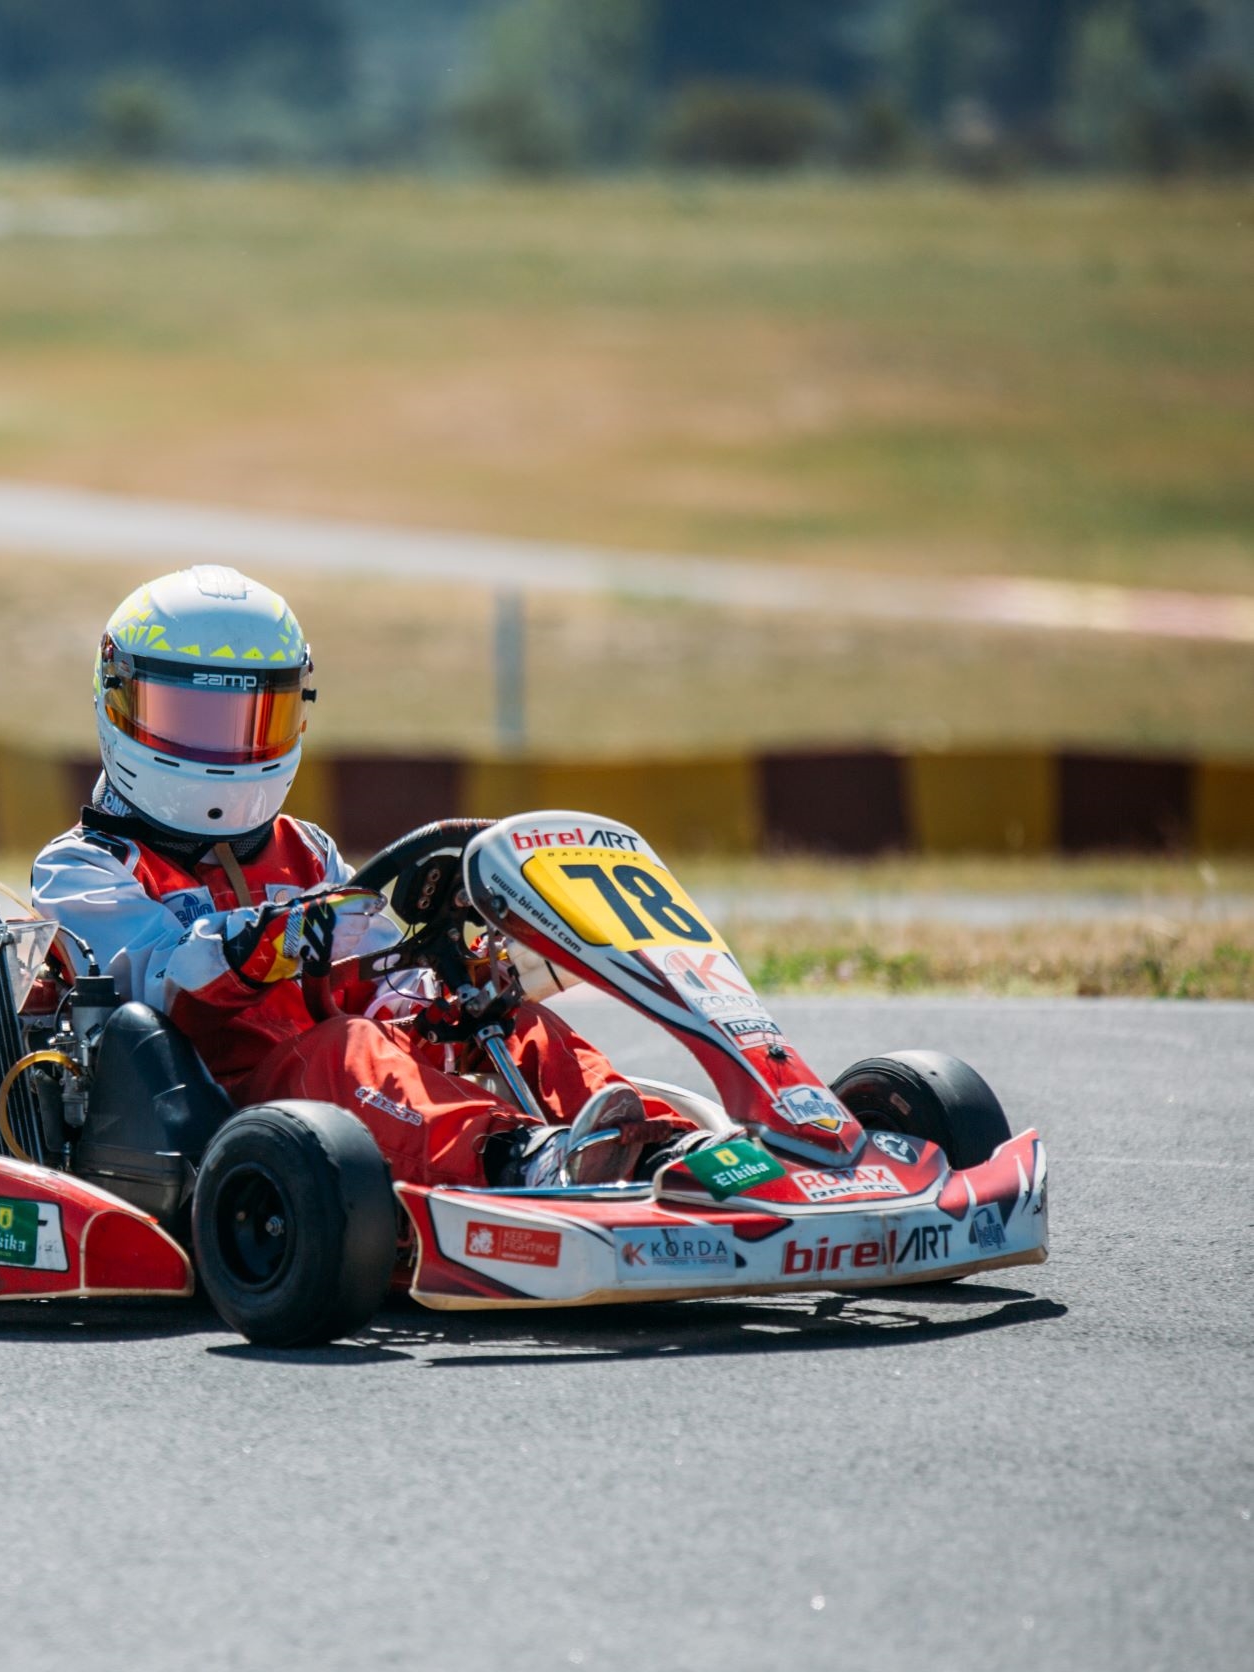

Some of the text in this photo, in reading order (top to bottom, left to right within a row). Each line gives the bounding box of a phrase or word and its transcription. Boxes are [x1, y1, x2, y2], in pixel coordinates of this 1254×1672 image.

[193, 672, 257, 691] zamp
[547, 852, 639, 861] BAPTISTE
[558, 864, 712, 942] 78
[491, 873, 582, 952] www.birelart.com
[712, 1160, 770, 1187] Elkika
[796, 1168, 891, 1191] ROTAX
[810, 1185, 901, 1199] RACING
[503, 1230, 532, 1241] KEEP
[502, 1239, 557, 1256] FIGHTING
[651, 1240, 728, 1258] KORDA
